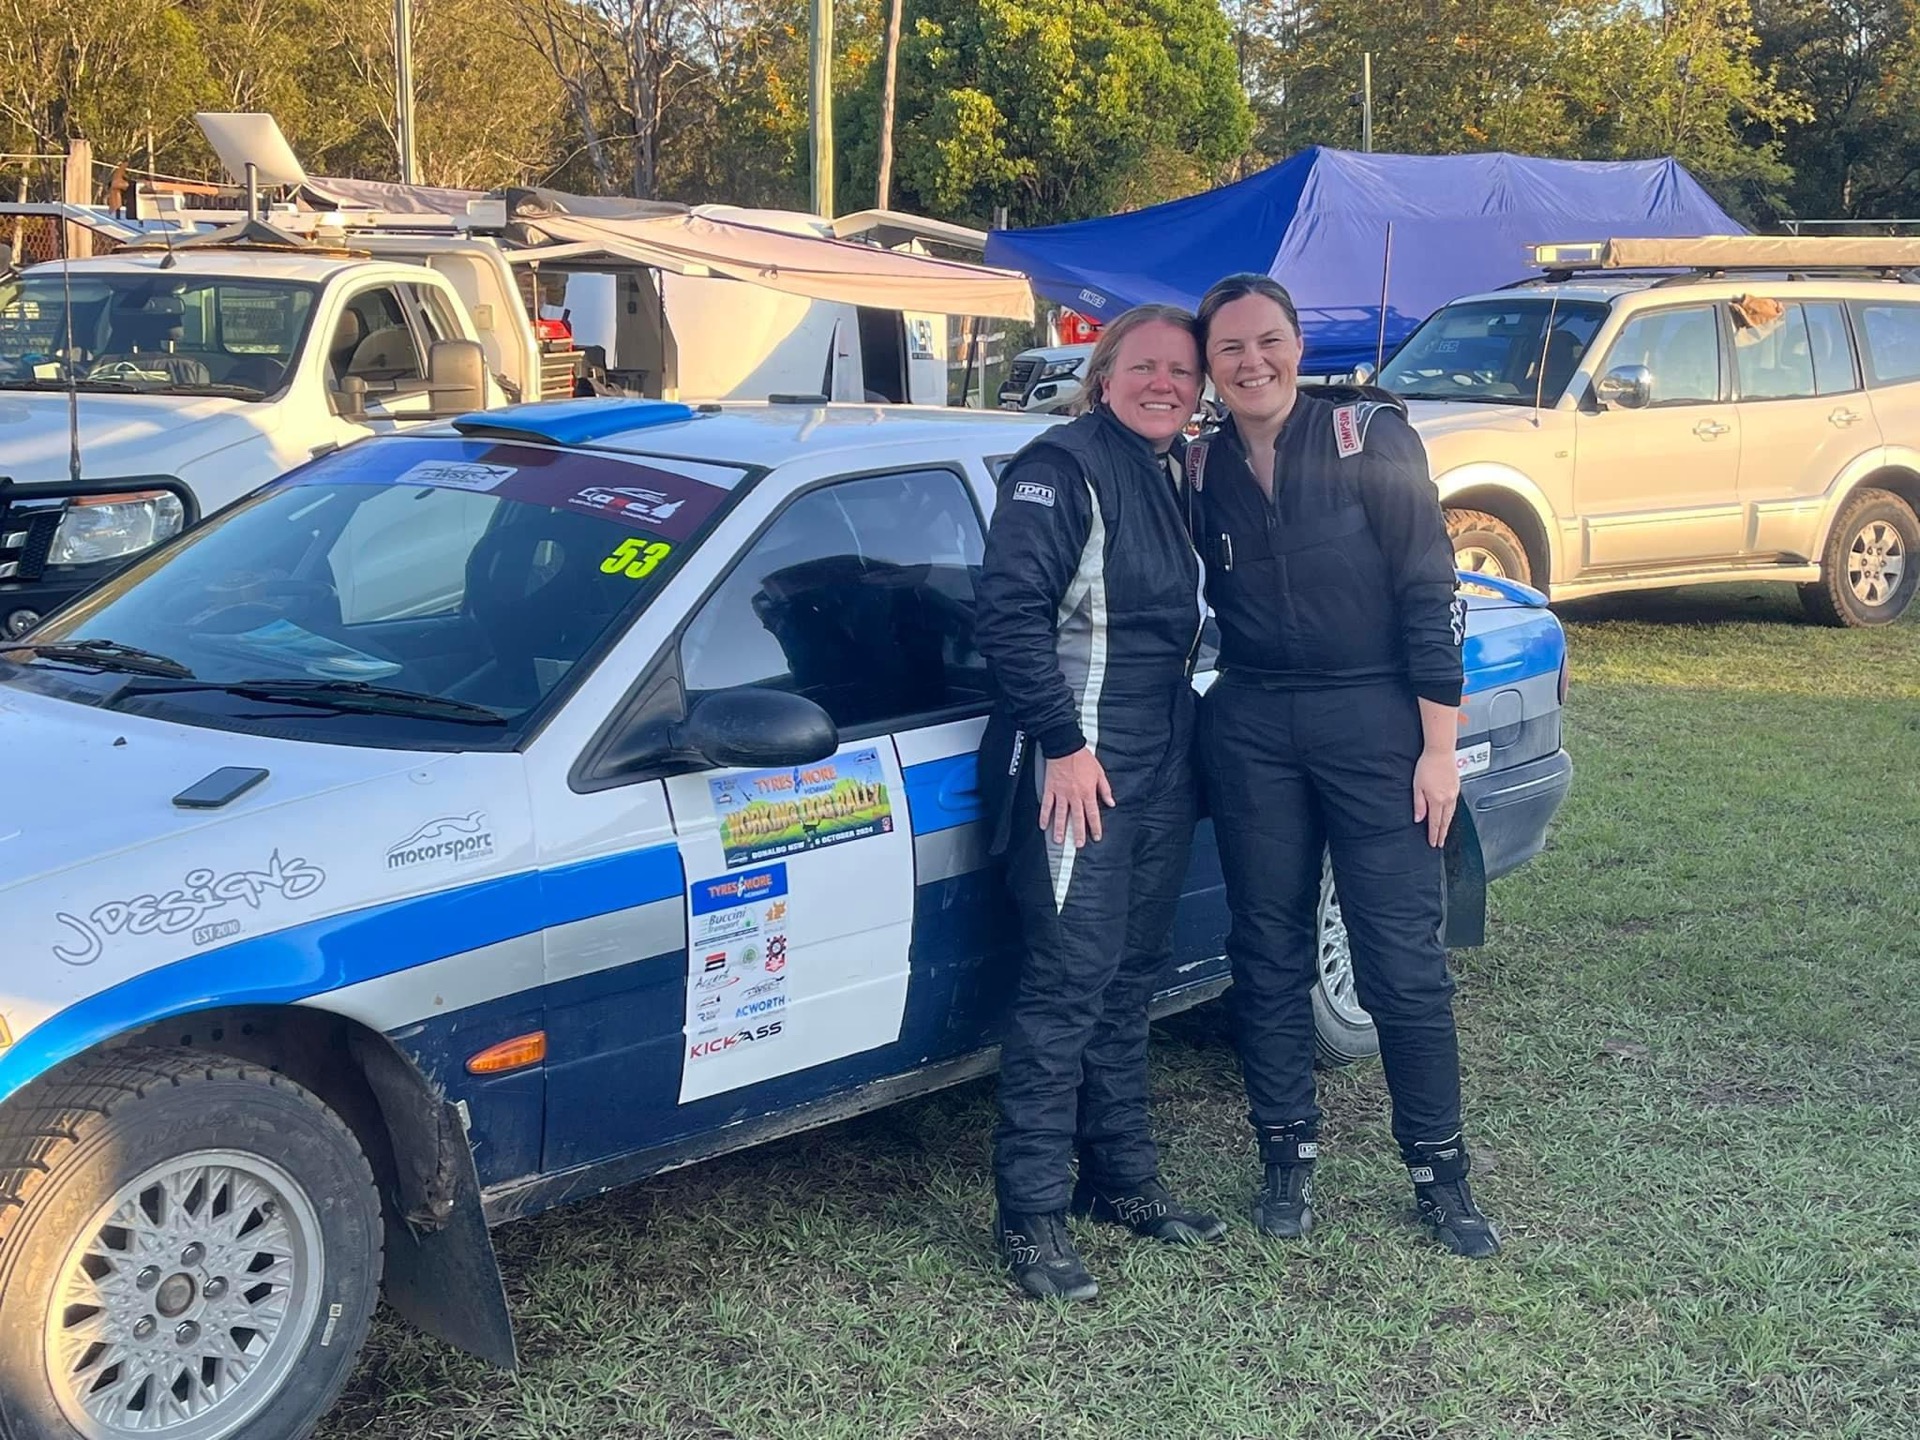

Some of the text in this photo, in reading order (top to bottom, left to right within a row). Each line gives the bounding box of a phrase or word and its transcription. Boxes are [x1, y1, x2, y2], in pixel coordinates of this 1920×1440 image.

[1343, 411, 1355, 449] SIMPSON
[1018, 485, 1053, 498] rpm
[599, 538, 672, 579] 53
[753, 777, 794, 795] TYRES
[801, 764, 838, 788] MORE
[726, 782, 882, 838] WORKING DOG RALLY
[388, 833, 493, 868] motorsport
[788, 841, 805, 851] NSW
[821, 830, 855, 844] OCTOBER
[856, 826, 874, 836] 2024
[708, 882, 739, 898] TYRES
[744, 874, 773, 890] MORE
[708, 907, 747, 926] Buccini
[194, 920, 240, 944] EST 2010
[735, 996, 785, 1018] ACWORTH
